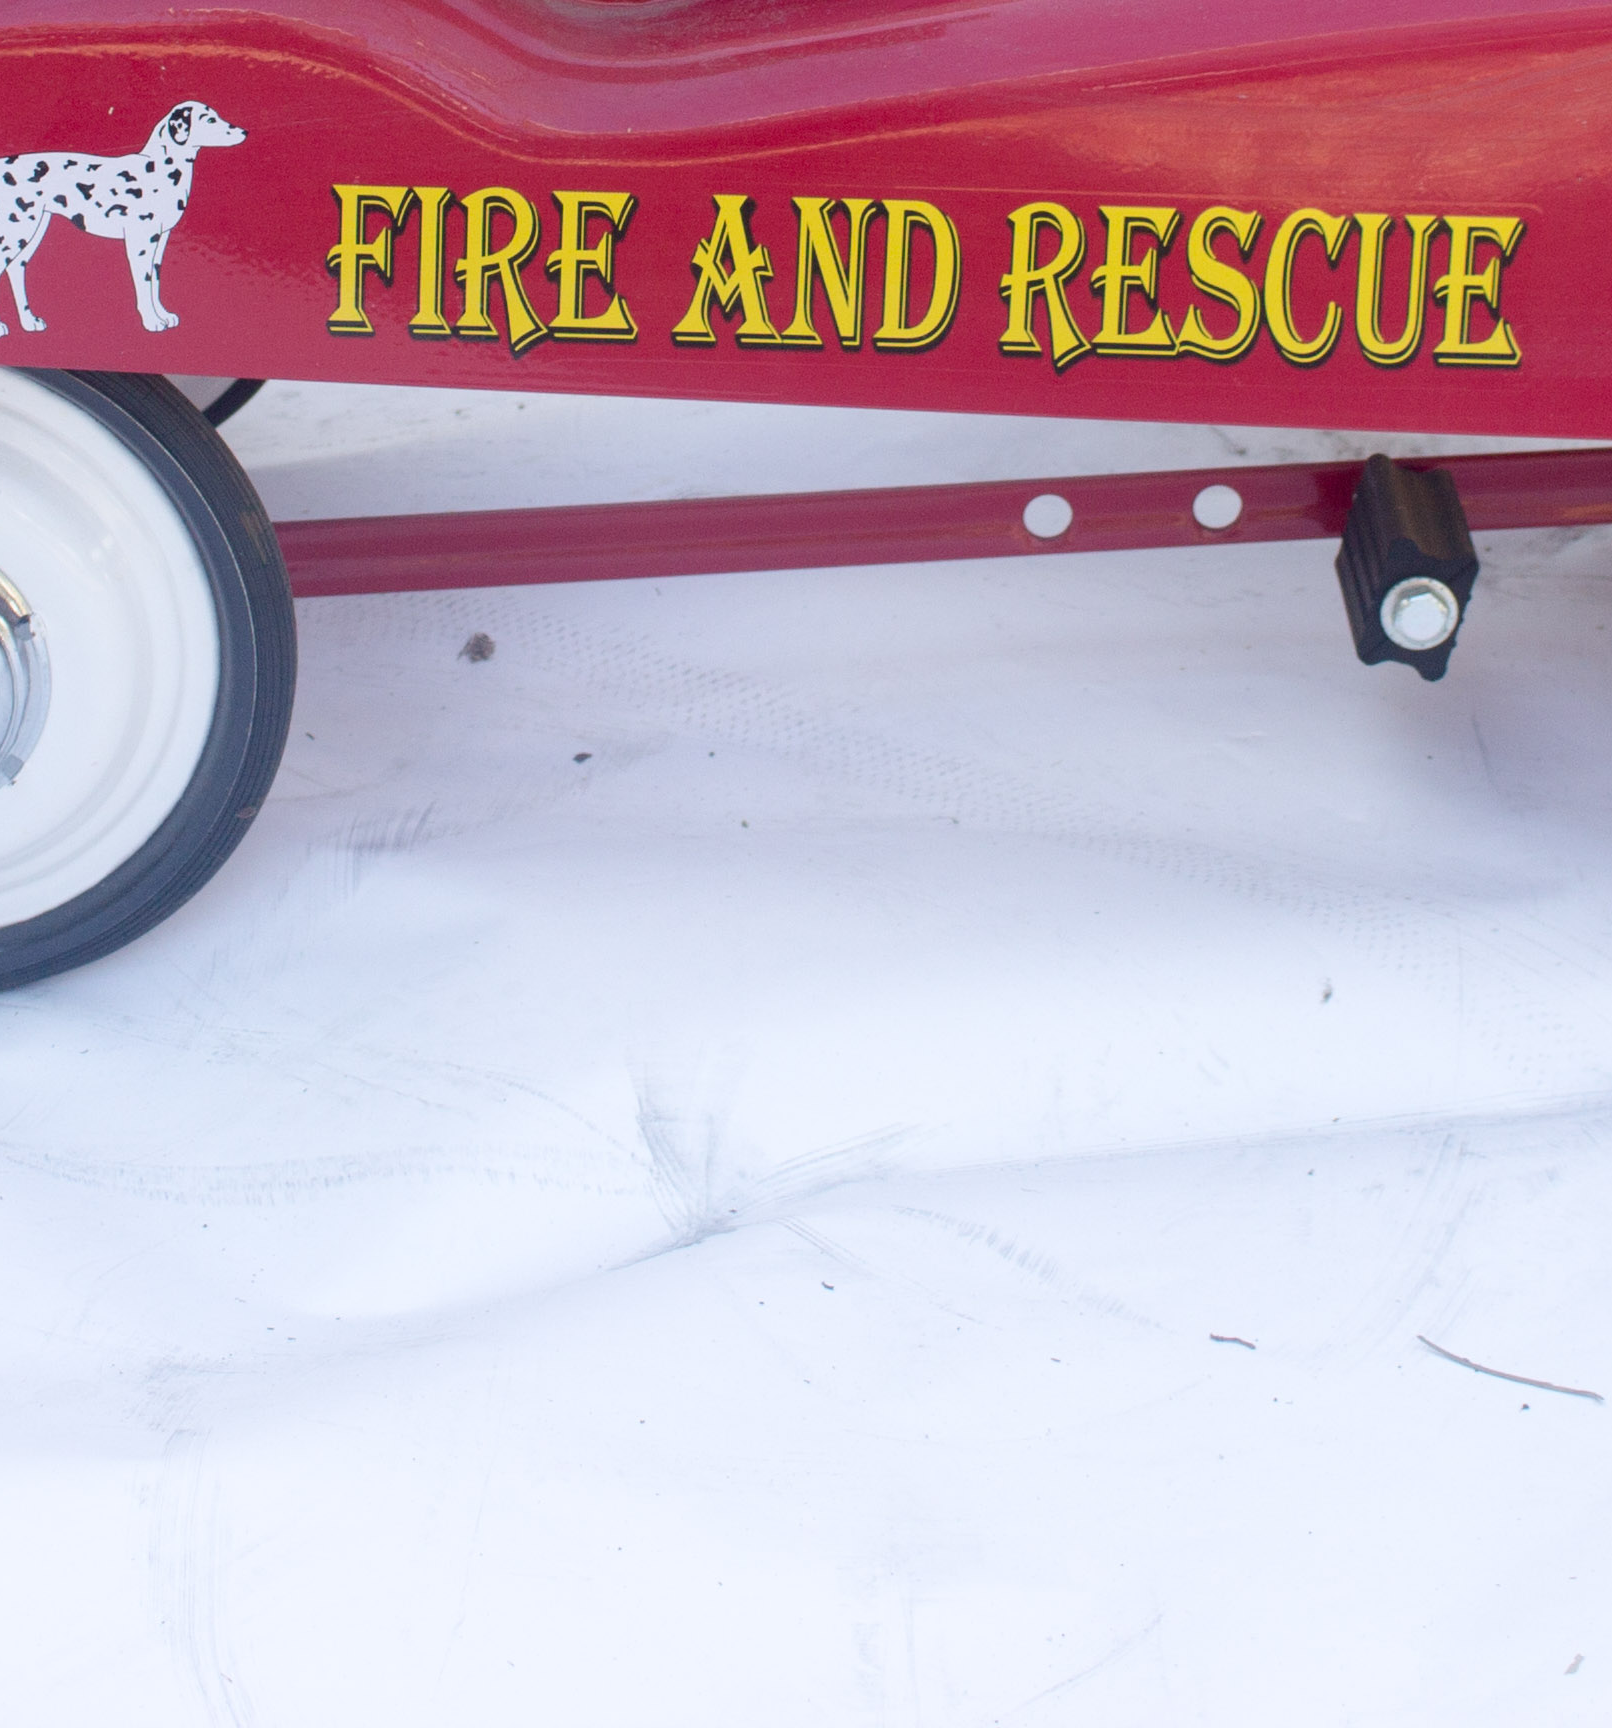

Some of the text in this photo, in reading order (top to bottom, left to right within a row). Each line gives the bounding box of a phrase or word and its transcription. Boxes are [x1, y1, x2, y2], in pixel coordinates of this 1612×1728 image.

[326, 183, 1527, 373] FIRE AND RESCUE
